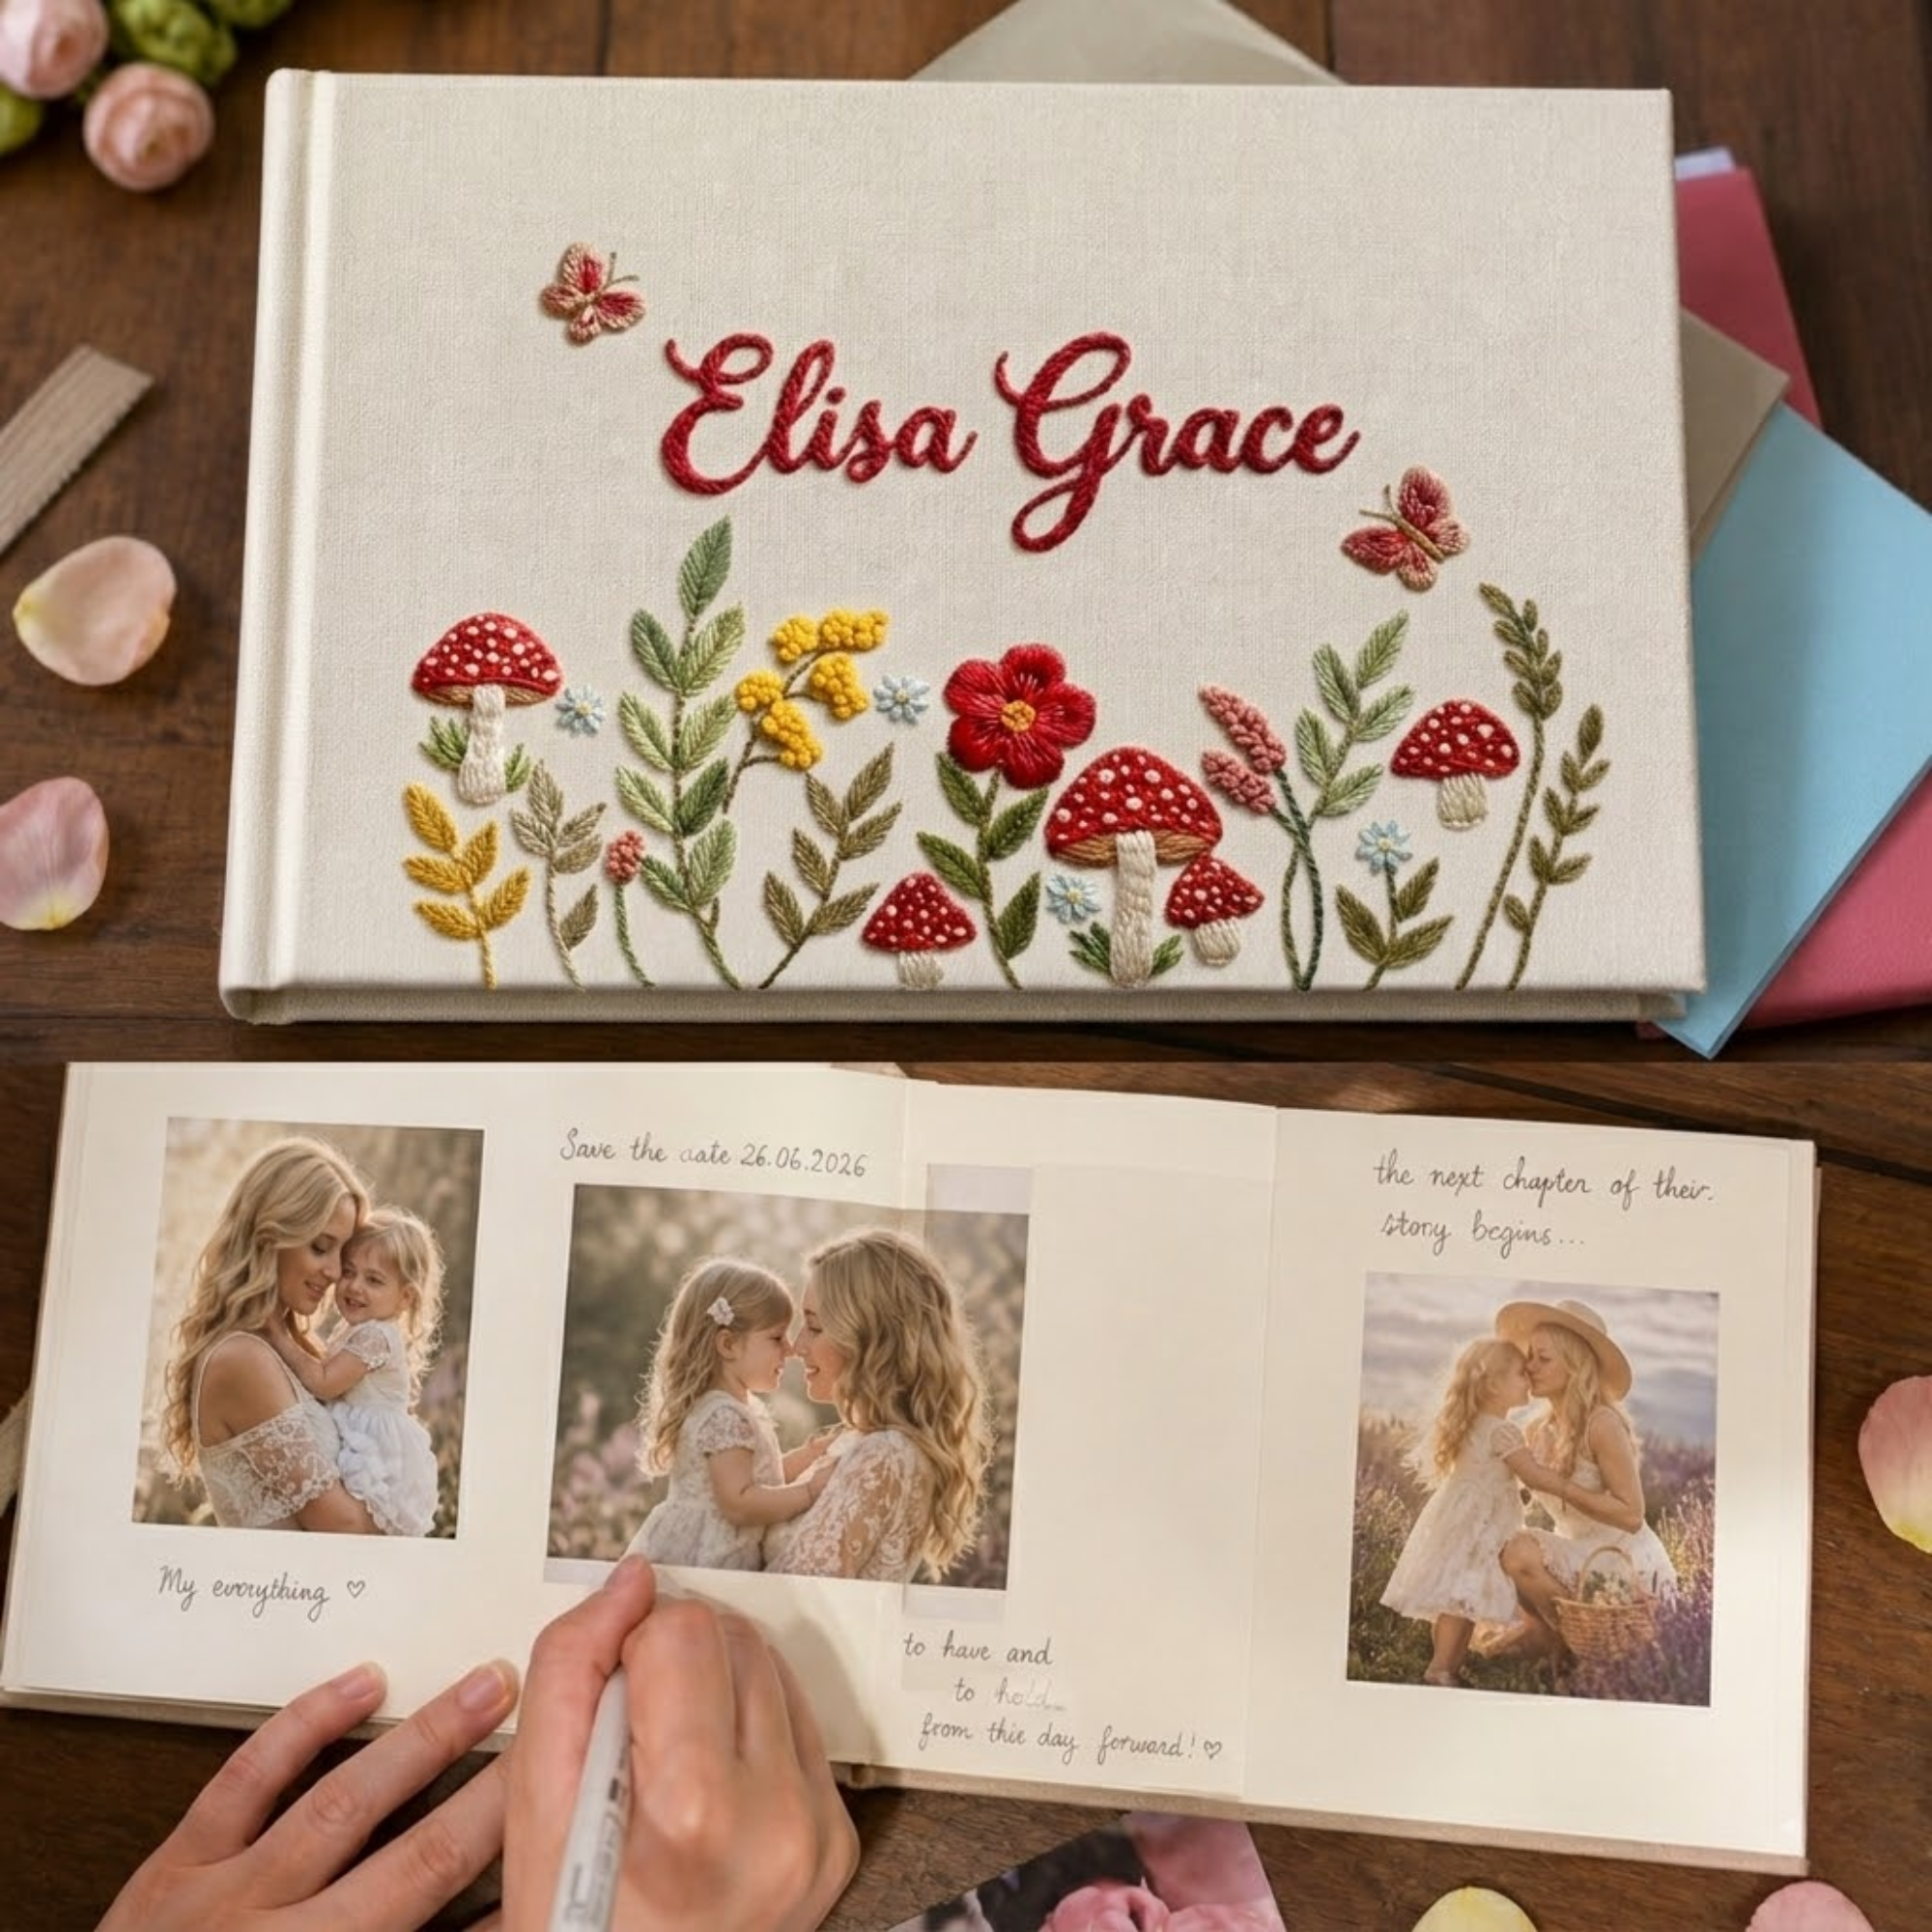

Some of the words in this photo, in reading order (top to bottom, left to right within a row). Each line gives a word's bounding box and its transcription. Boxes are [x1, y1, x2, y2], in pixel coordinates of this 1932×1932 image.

[661, 334, 977, 497] Elisa
[994, 333, 1361, 553] Grace
[559, 1126, 617, 1161] Save
[629, 1131, 668, 1163] the
[739, 1142, 868, 1178] 26.06.2026
[1373, 1148, 1415, 1186] the
[1428, 1164, 1486, 1198] next
[1502, 1154, 1593, 1209] chapter
[1608, 1168, 1641, 1212] of
[157, 1564, 199, 1612] My
[902, 1632, 926, 1658] to
[942, 1629, 992, 1662] have
[1006, 1636, 1054, 1666] and
[953, 1676, 976, 1703] to
[919, 1712, 974, 1751] from
[1037, 1721, 1080, 1767] day
